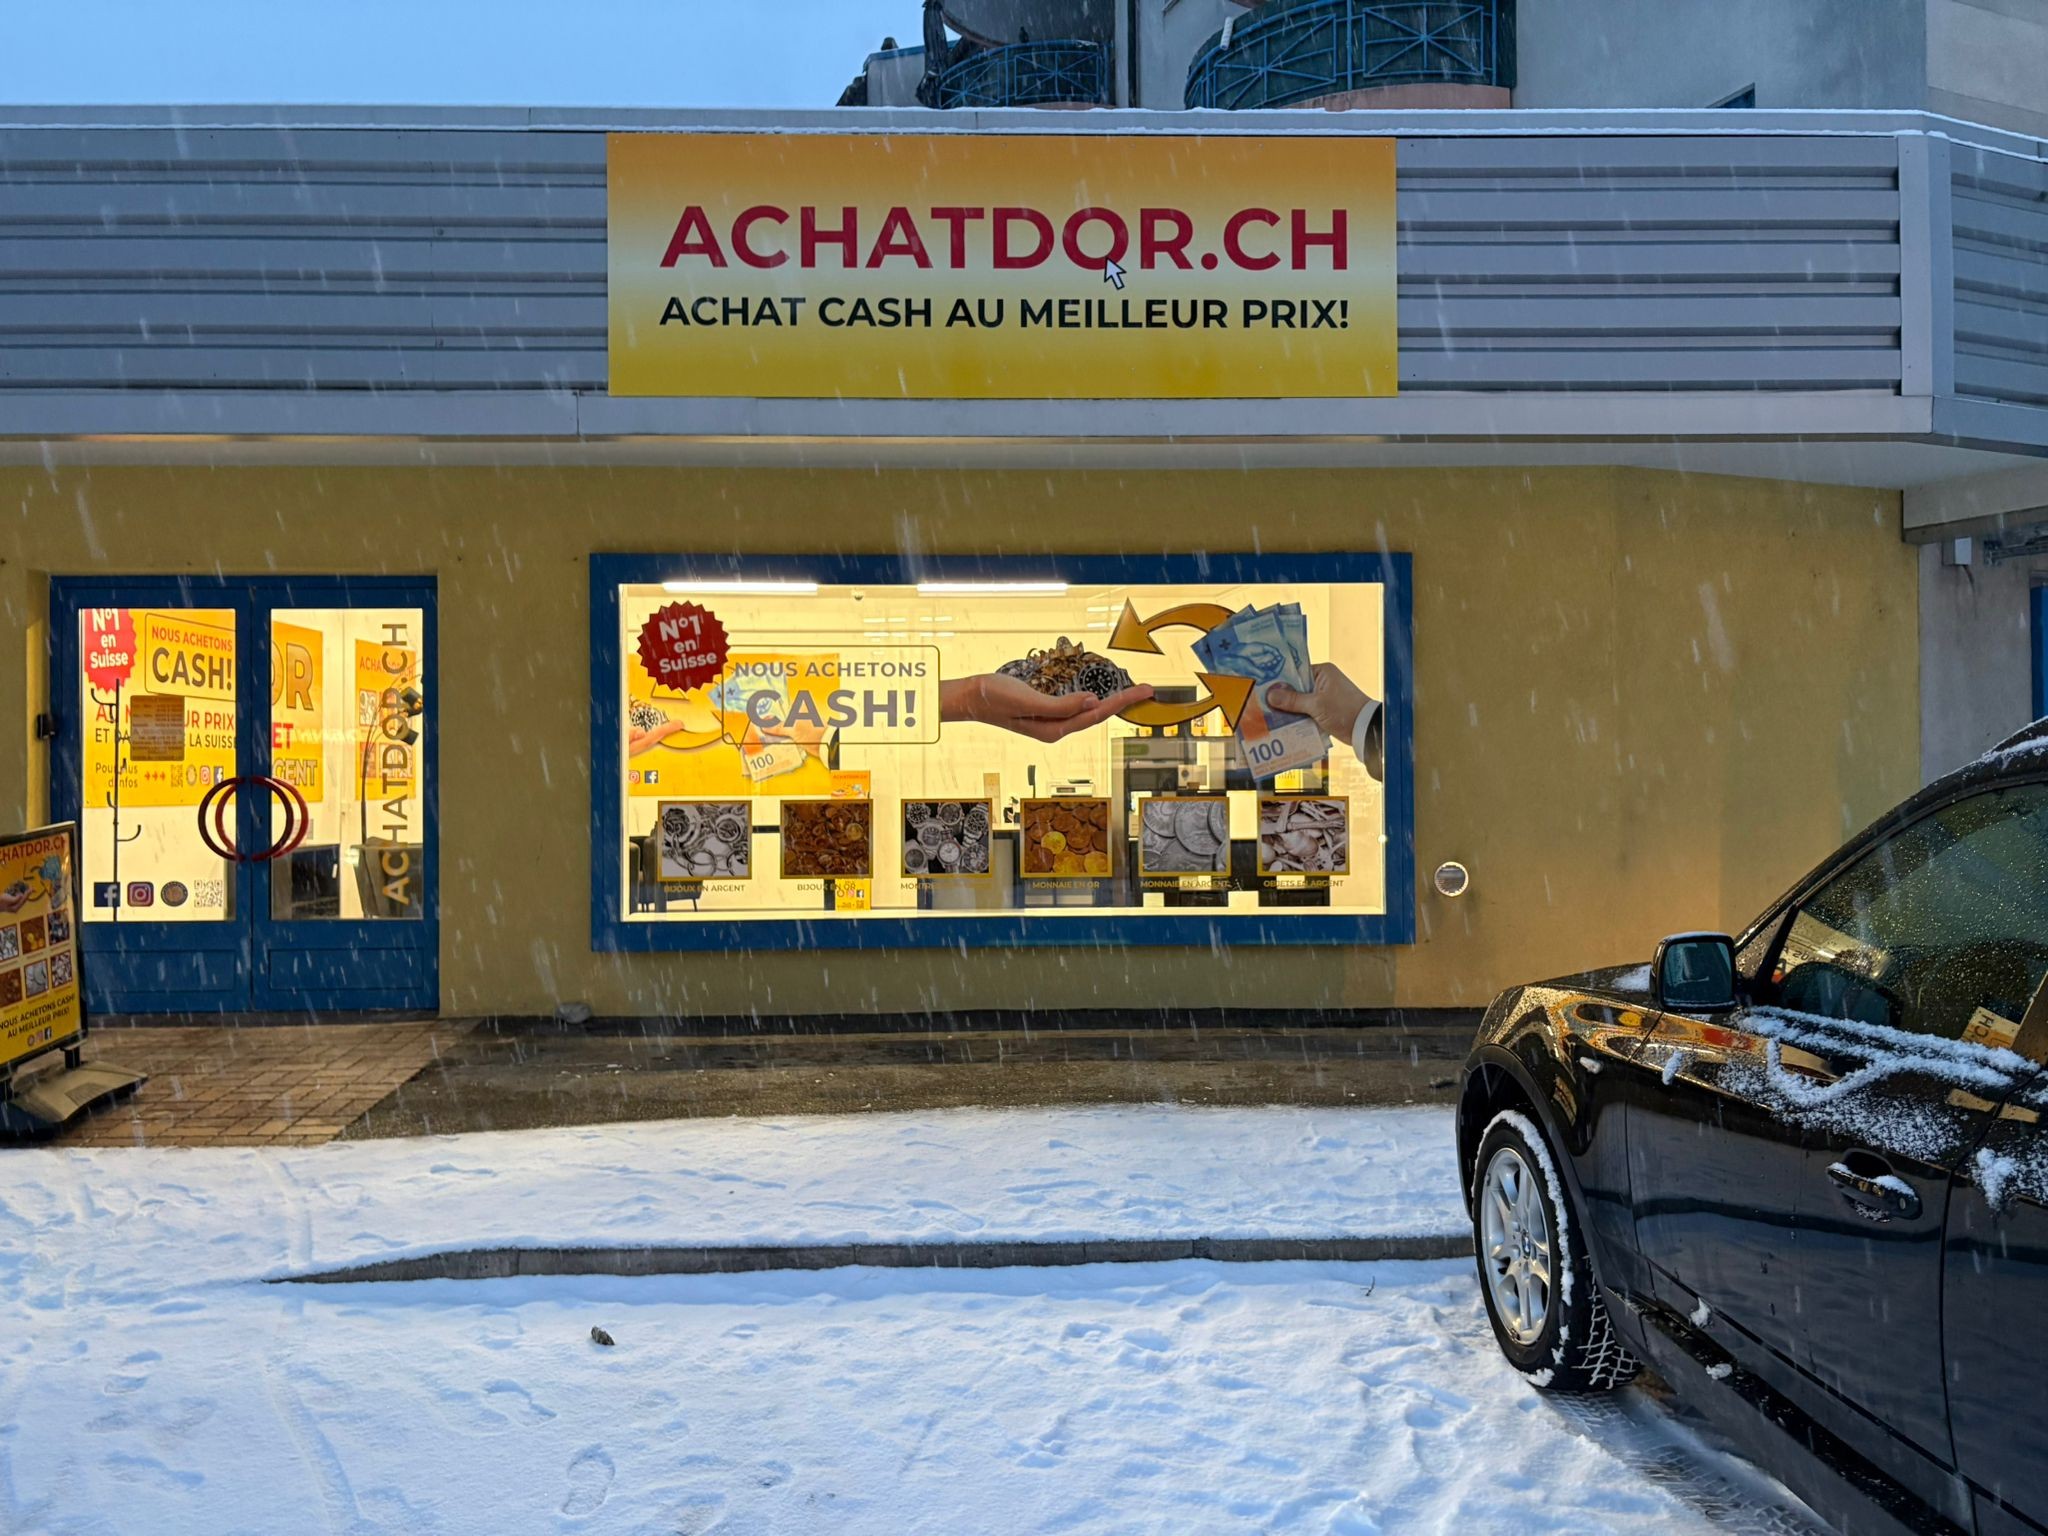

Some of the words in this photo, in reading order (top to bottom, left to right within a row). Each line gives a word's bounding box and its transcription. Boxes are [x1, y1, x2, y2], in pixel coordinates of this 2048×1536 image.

[659, 205, 1348, 271] ACHATDOR.CH
[659, 297, 806, 327] ACHAT
[818, 297, 932, 328] CASH
[945, 298, 1004, 328] AU
[1020, 298, 1229, 329] MEILLEUR
[1242, 299, 1349, 330] PRIX!
[101, 634, 116, 648] en
[152, 626, 180, 643] NOUS
[183, 631, 232, 652] ACHETONS
[674, 639, 697, 653] en
[90, 649, 128, 669] Suisse
[152, 647, 232, 691] CASH!
[659, 652, 717, 673] Suisse
[735, 662, 798, 677] NOUS
[805, 662, 926, 677] ACHETONS
[746, 689, 916, 728] CASH!
[204, 711, 234, 731] PRIX
[95, 728, 110, 743] ET
[190, 733, 202, 748] LA
[204, 734, 236, 749] SUISS
[1249, 738, 1284, 764] 100
[95, 763, 115, 774] Pou
[750, 752, 775, 772] 100
[711, 884, 746, 892] ARGENT
